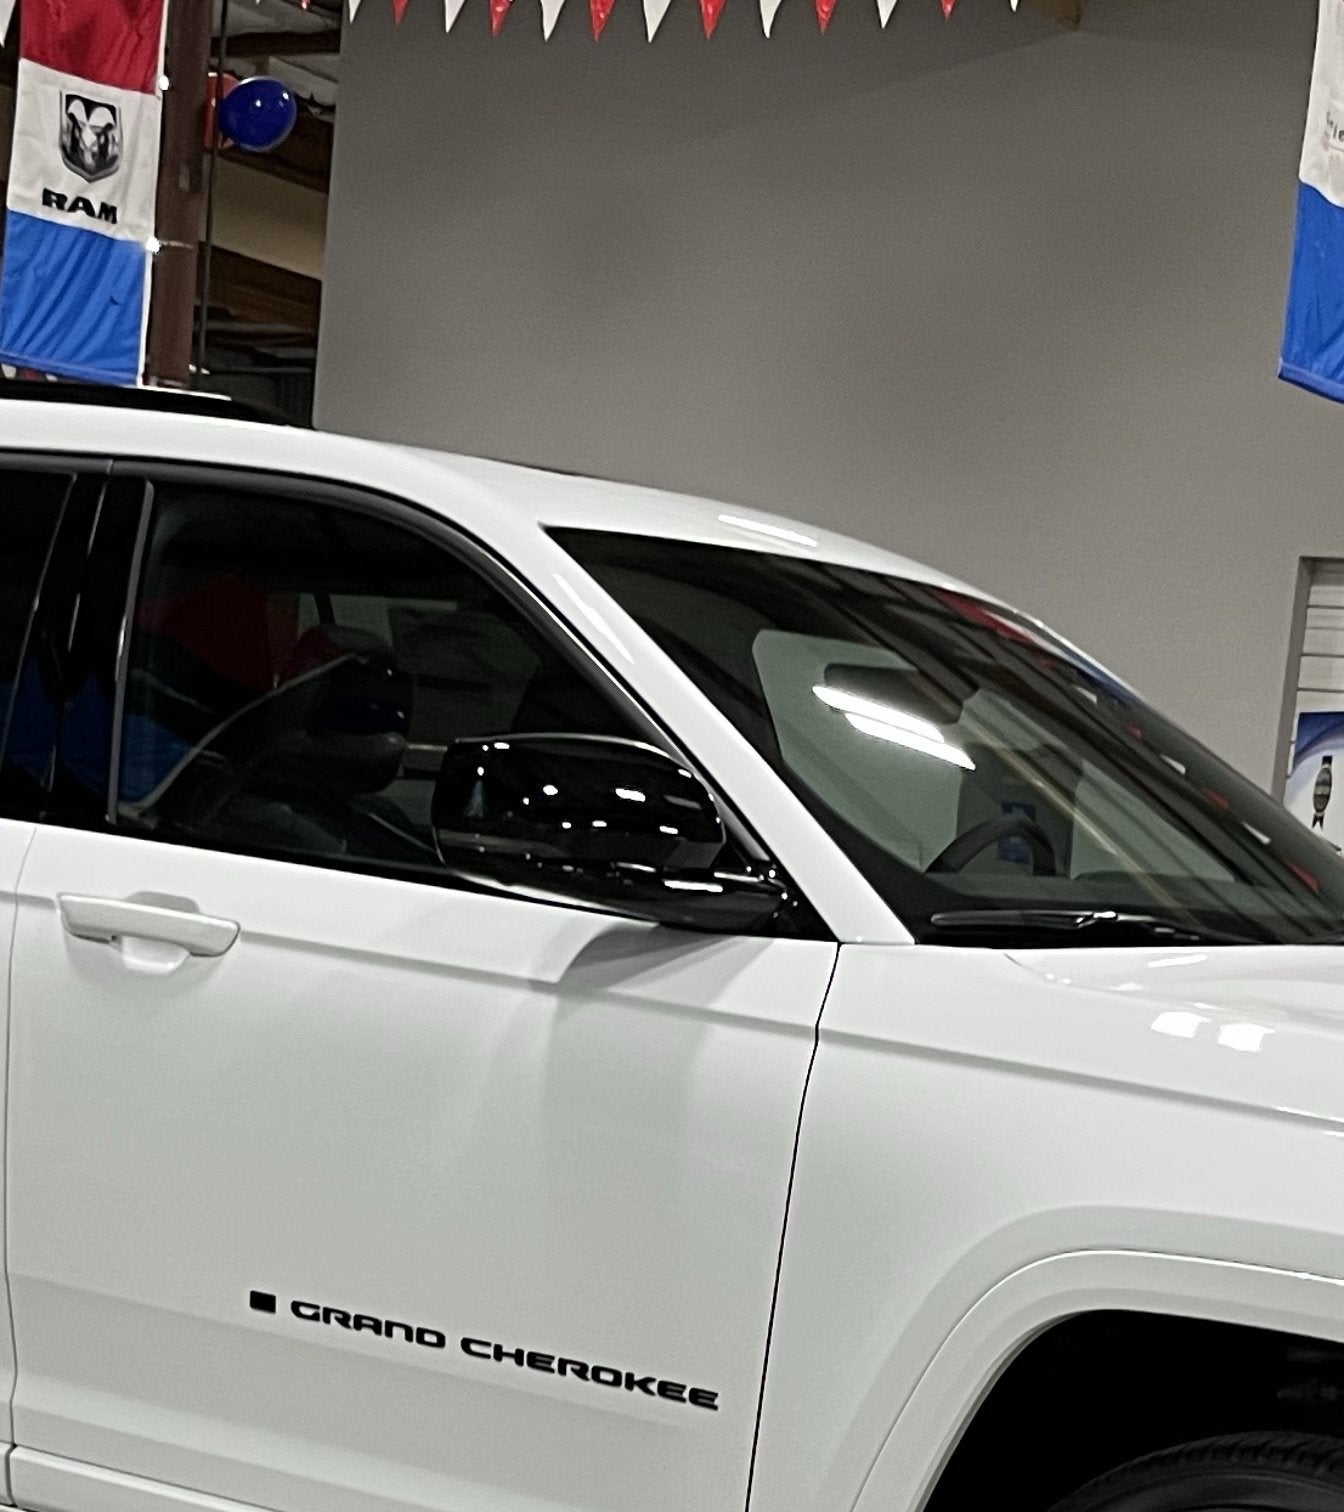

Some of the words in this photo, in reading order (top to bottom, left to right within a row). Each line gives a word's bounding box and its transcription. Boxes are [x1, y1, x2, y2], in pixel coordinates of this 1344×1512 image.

[42, 187, 117, 225] RAM
[290, 1300, 446, 1349] GRAND
[460, 1337, 719, 1411] CHEROKEE
